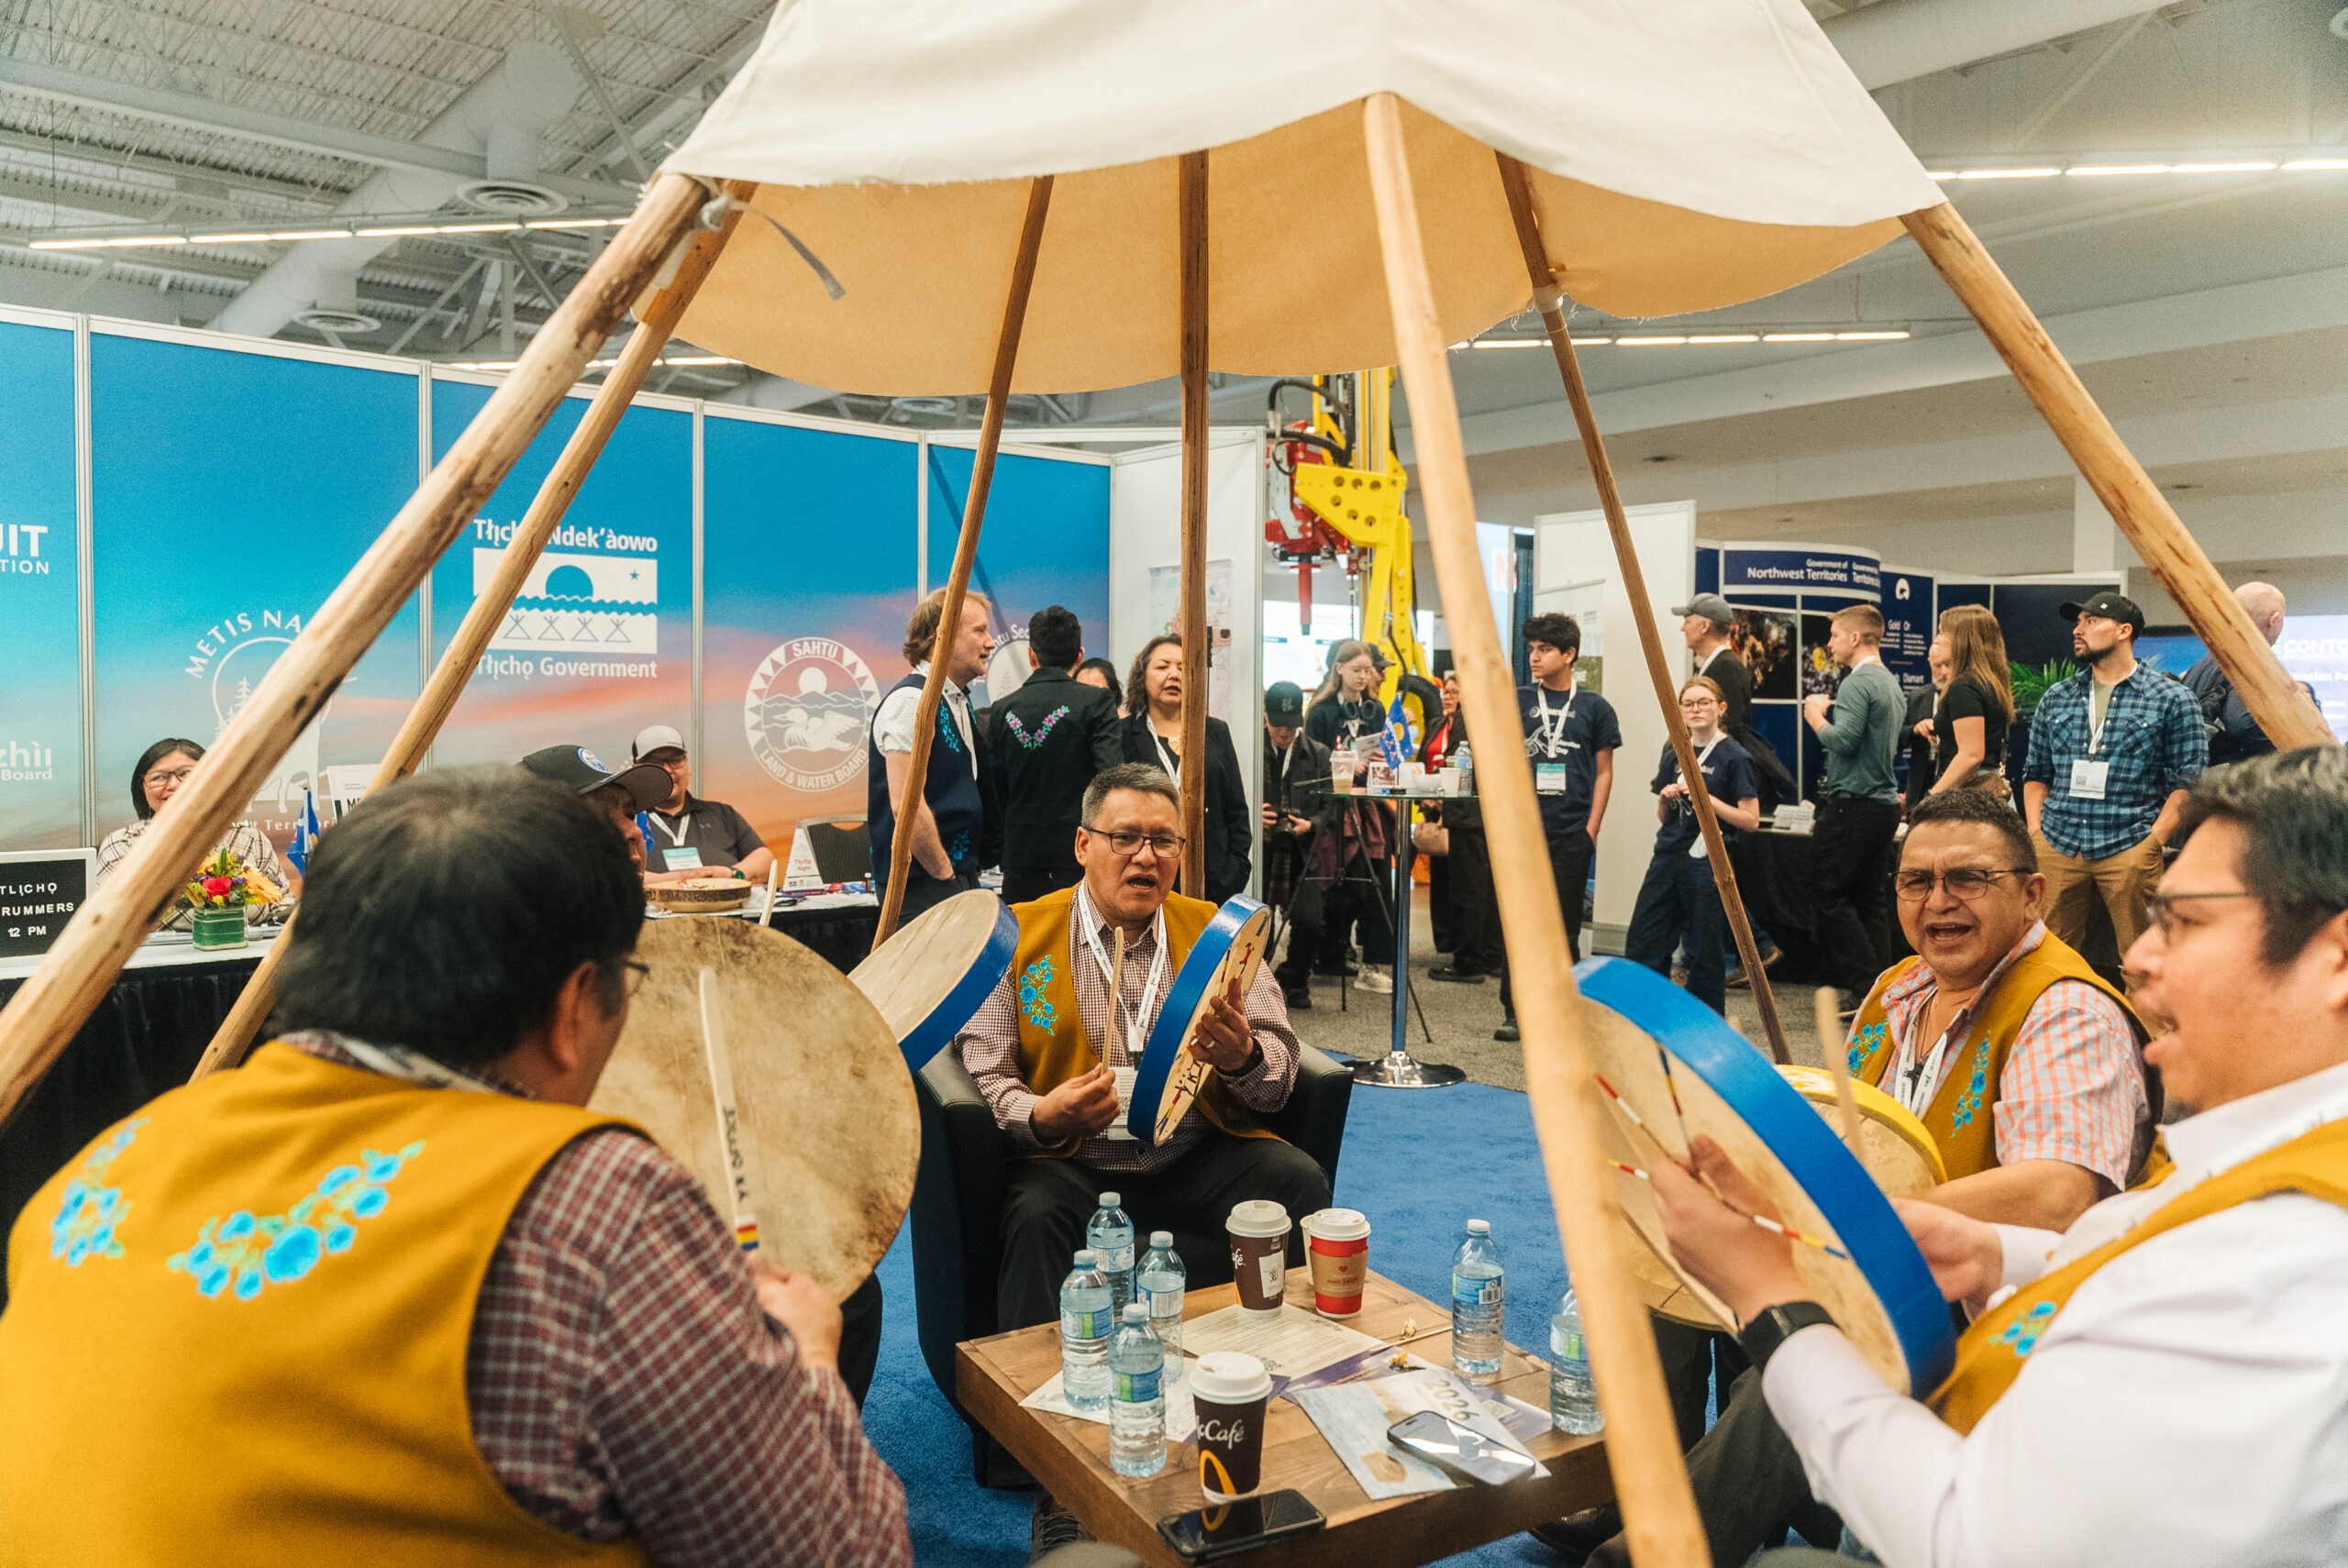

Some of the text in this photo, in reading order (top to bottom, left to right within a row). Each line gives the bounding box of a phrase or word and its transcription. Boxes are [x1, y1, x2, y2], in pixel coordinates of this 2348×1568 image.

[0, 524, 49, 558] IT
[1806, 558, 1848, 569] Government of
[1747, 567, 1848, 582] Northwest Territories
[184, 613, 252, 679] METIS
[792, 641, 839, 659] SAHTU
[539, 657, 658, 678] Government
[1, 767, 53, 780] Board
[759, 748, 868, 789] LAND & WATER BOARD
[1, 902, 74, 917] RUMMERS
[7, 925, 47, 937] 12 PM
[1423, 1379, 1480, 1422] 2026
